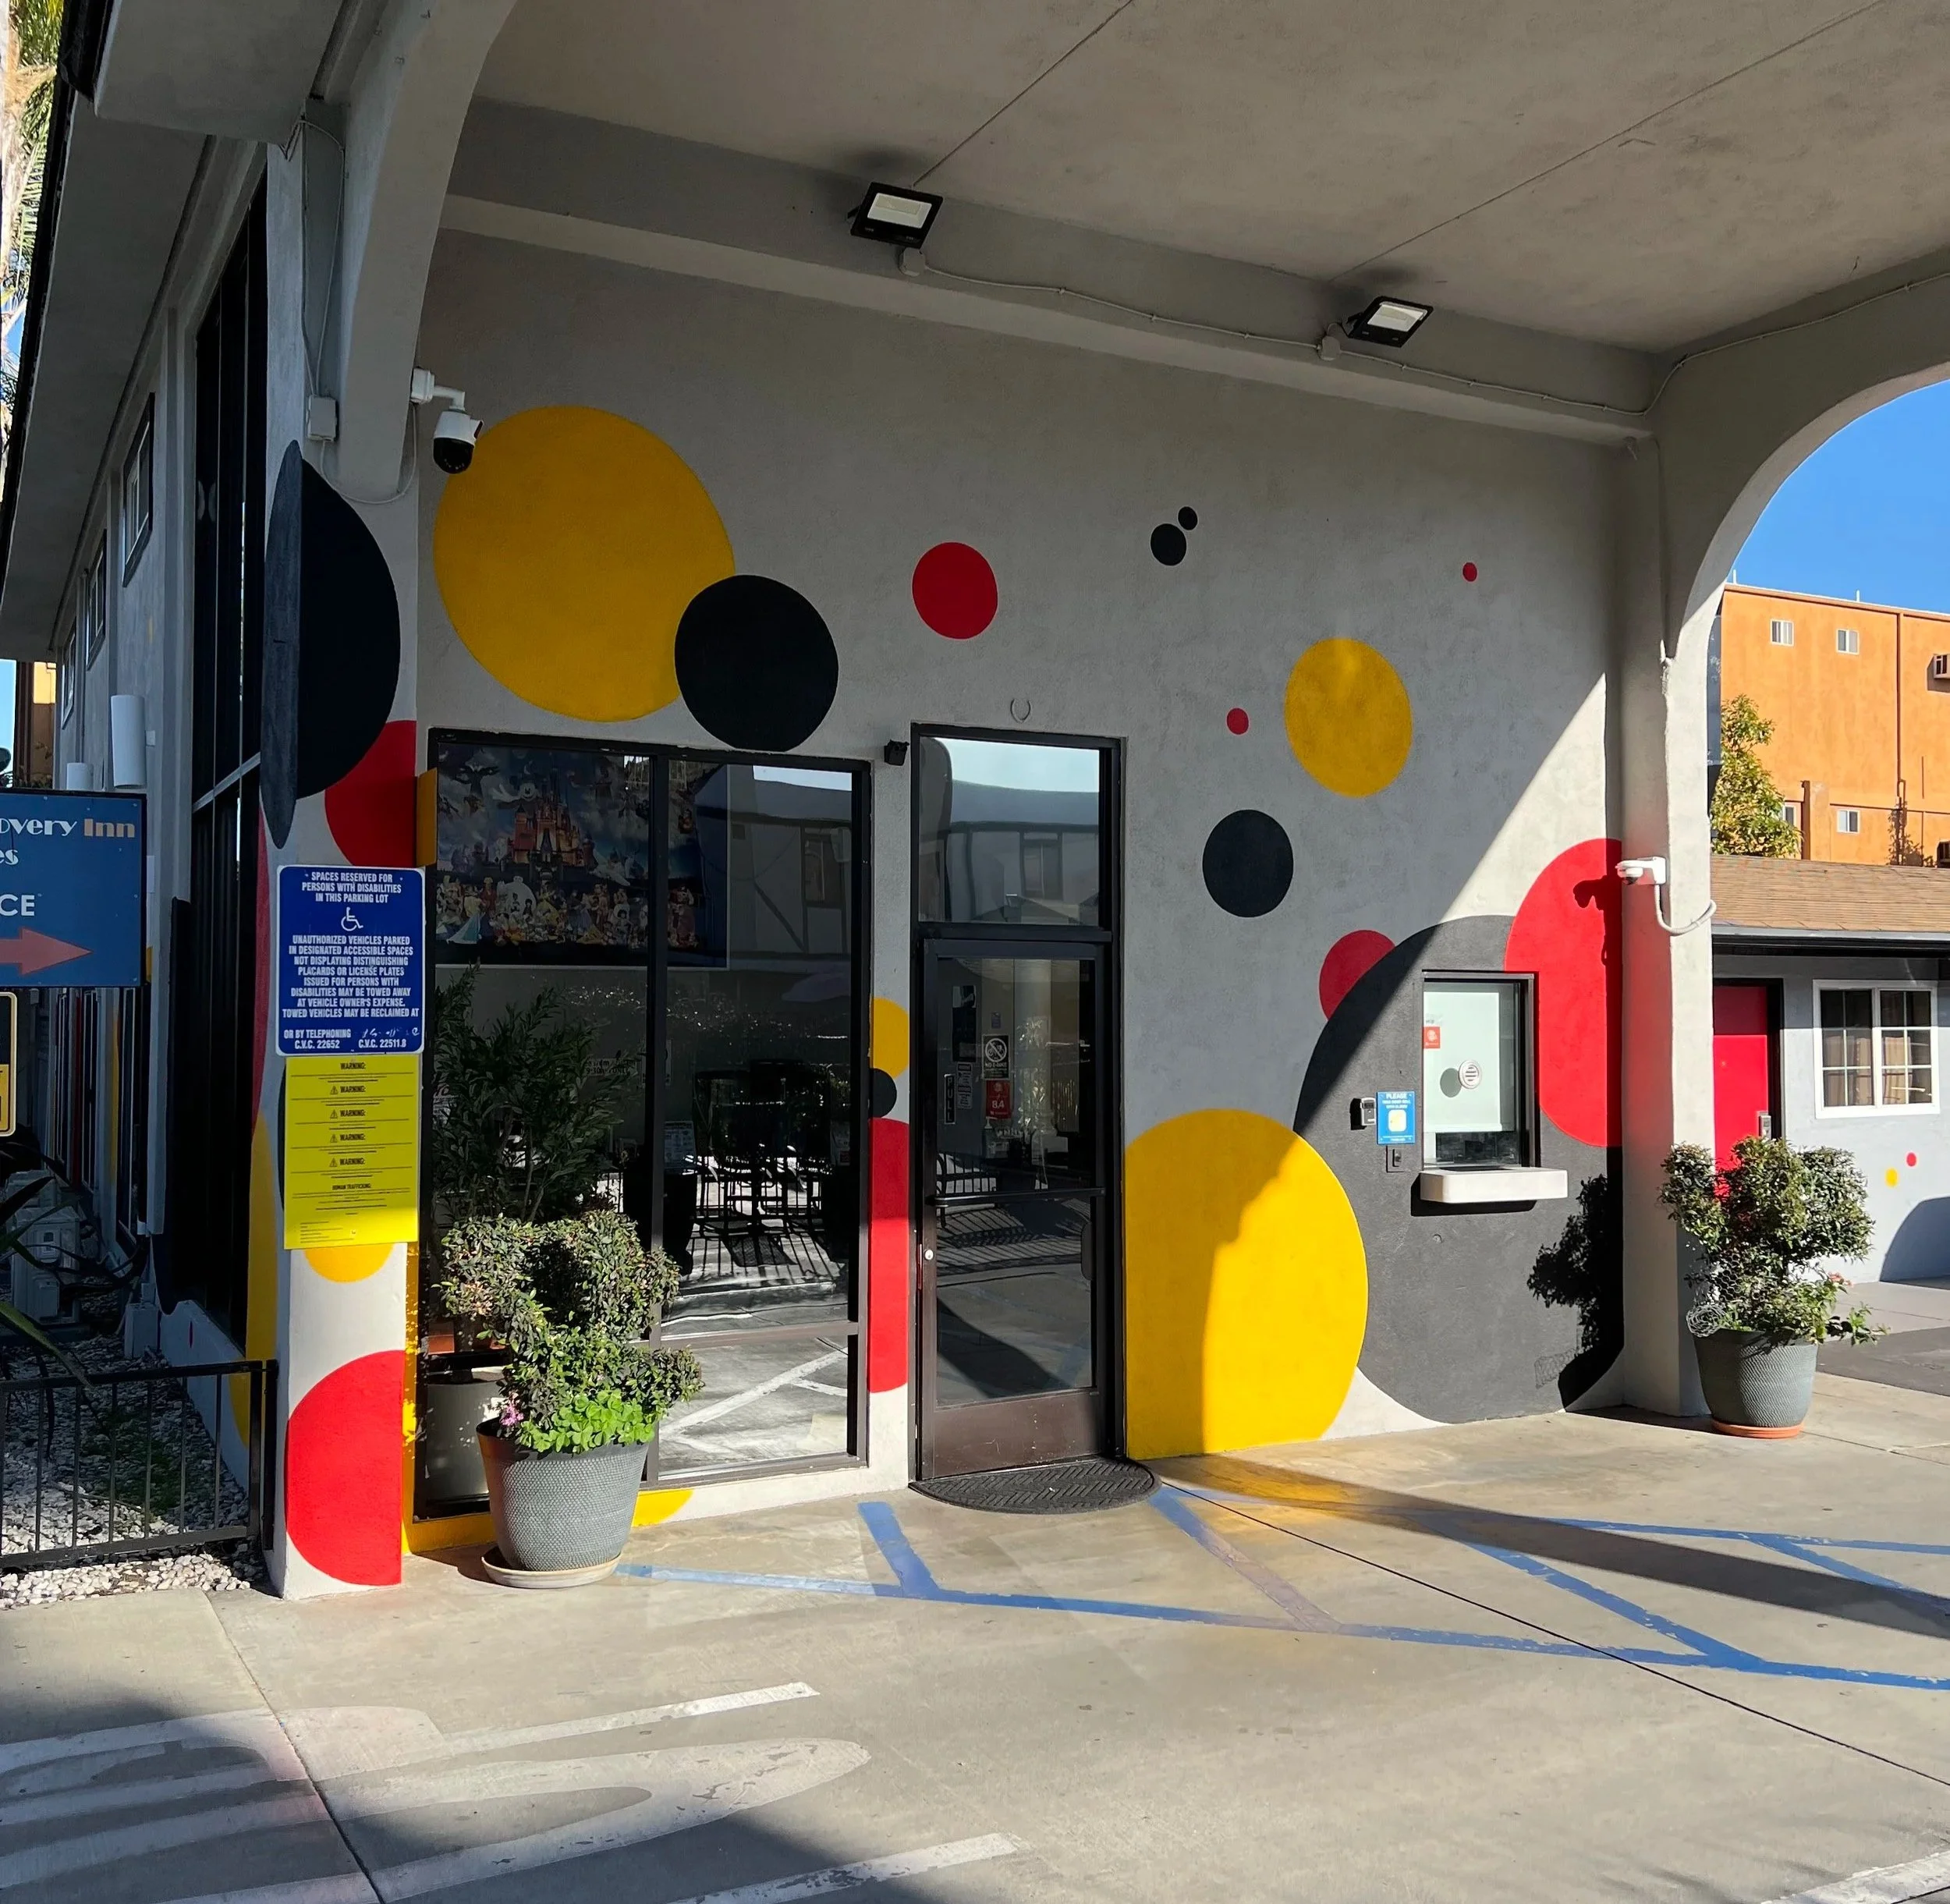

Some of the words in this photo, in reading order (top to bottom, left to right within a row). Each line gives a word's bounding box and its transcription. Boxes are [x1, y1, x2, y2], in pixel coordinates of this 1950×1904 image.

[84, 818, 135, 838] Inn
[311, 872, 339, 881] SPACES
[341, 873, 377, 881] RESERVED
[302, 882, 335, 892] PERSONS
[337, 883, 355, 892] WITH
[357, 884, 401, 893] DISABILITIES
[316, 893, 323, 902] IN
[325, 893, 342, 902] THIS
[343, 894, 374, 902] PARKING
[292, 935, 346, 944] UNAUTHORIZED
[349, 936, 381, 945] VEHICLES
[384, 936, 410, 945] PARKED
[343, 946, 385, 955] ACCESSIBLE
[294, 956, 308, 965] NOT
[310, 956, 351, 965] DISPLAYING
[353, 957, 408, 966] DISTINGUISHING
[379, 967, 404, 976] PLATES
[304, 977, 329, 986] ISSUED
[332, 977, 346, 986] FOR
[348, 977, 379, 986] PERSONS
[381, 977, 399, 986] WITH
[291, 988, 336, 997] DISABILITIES
[392, 987, 411, 996] AWAY
[297, 998, 307, 1007] AT
[308, 998, 338, 1007] VEHICLE
[339, 998, 370, 1007] OWNER'S
[283, 1009, 307, 1018] TOWED
[309, 1009, 342, 1018] VEHICLES
[344, 1009, 359, 1017] MAY
[360, 1009, 369, 1017] BE
[371, 1009, 409, 1017] RECLAIMED
[284, 1030, 293, 1038] OR
[296, 1030, 304, 1038] BY
[306, 1029, 351, 1038] TELEPHONING
[295, 1040, 315, 1049] C.V.C.
[317, 1040, 340, 1048] 22652
[359, 1040, 378, 1048] C.V.C.
[380, 1039, 406, 1048] 22511.8
